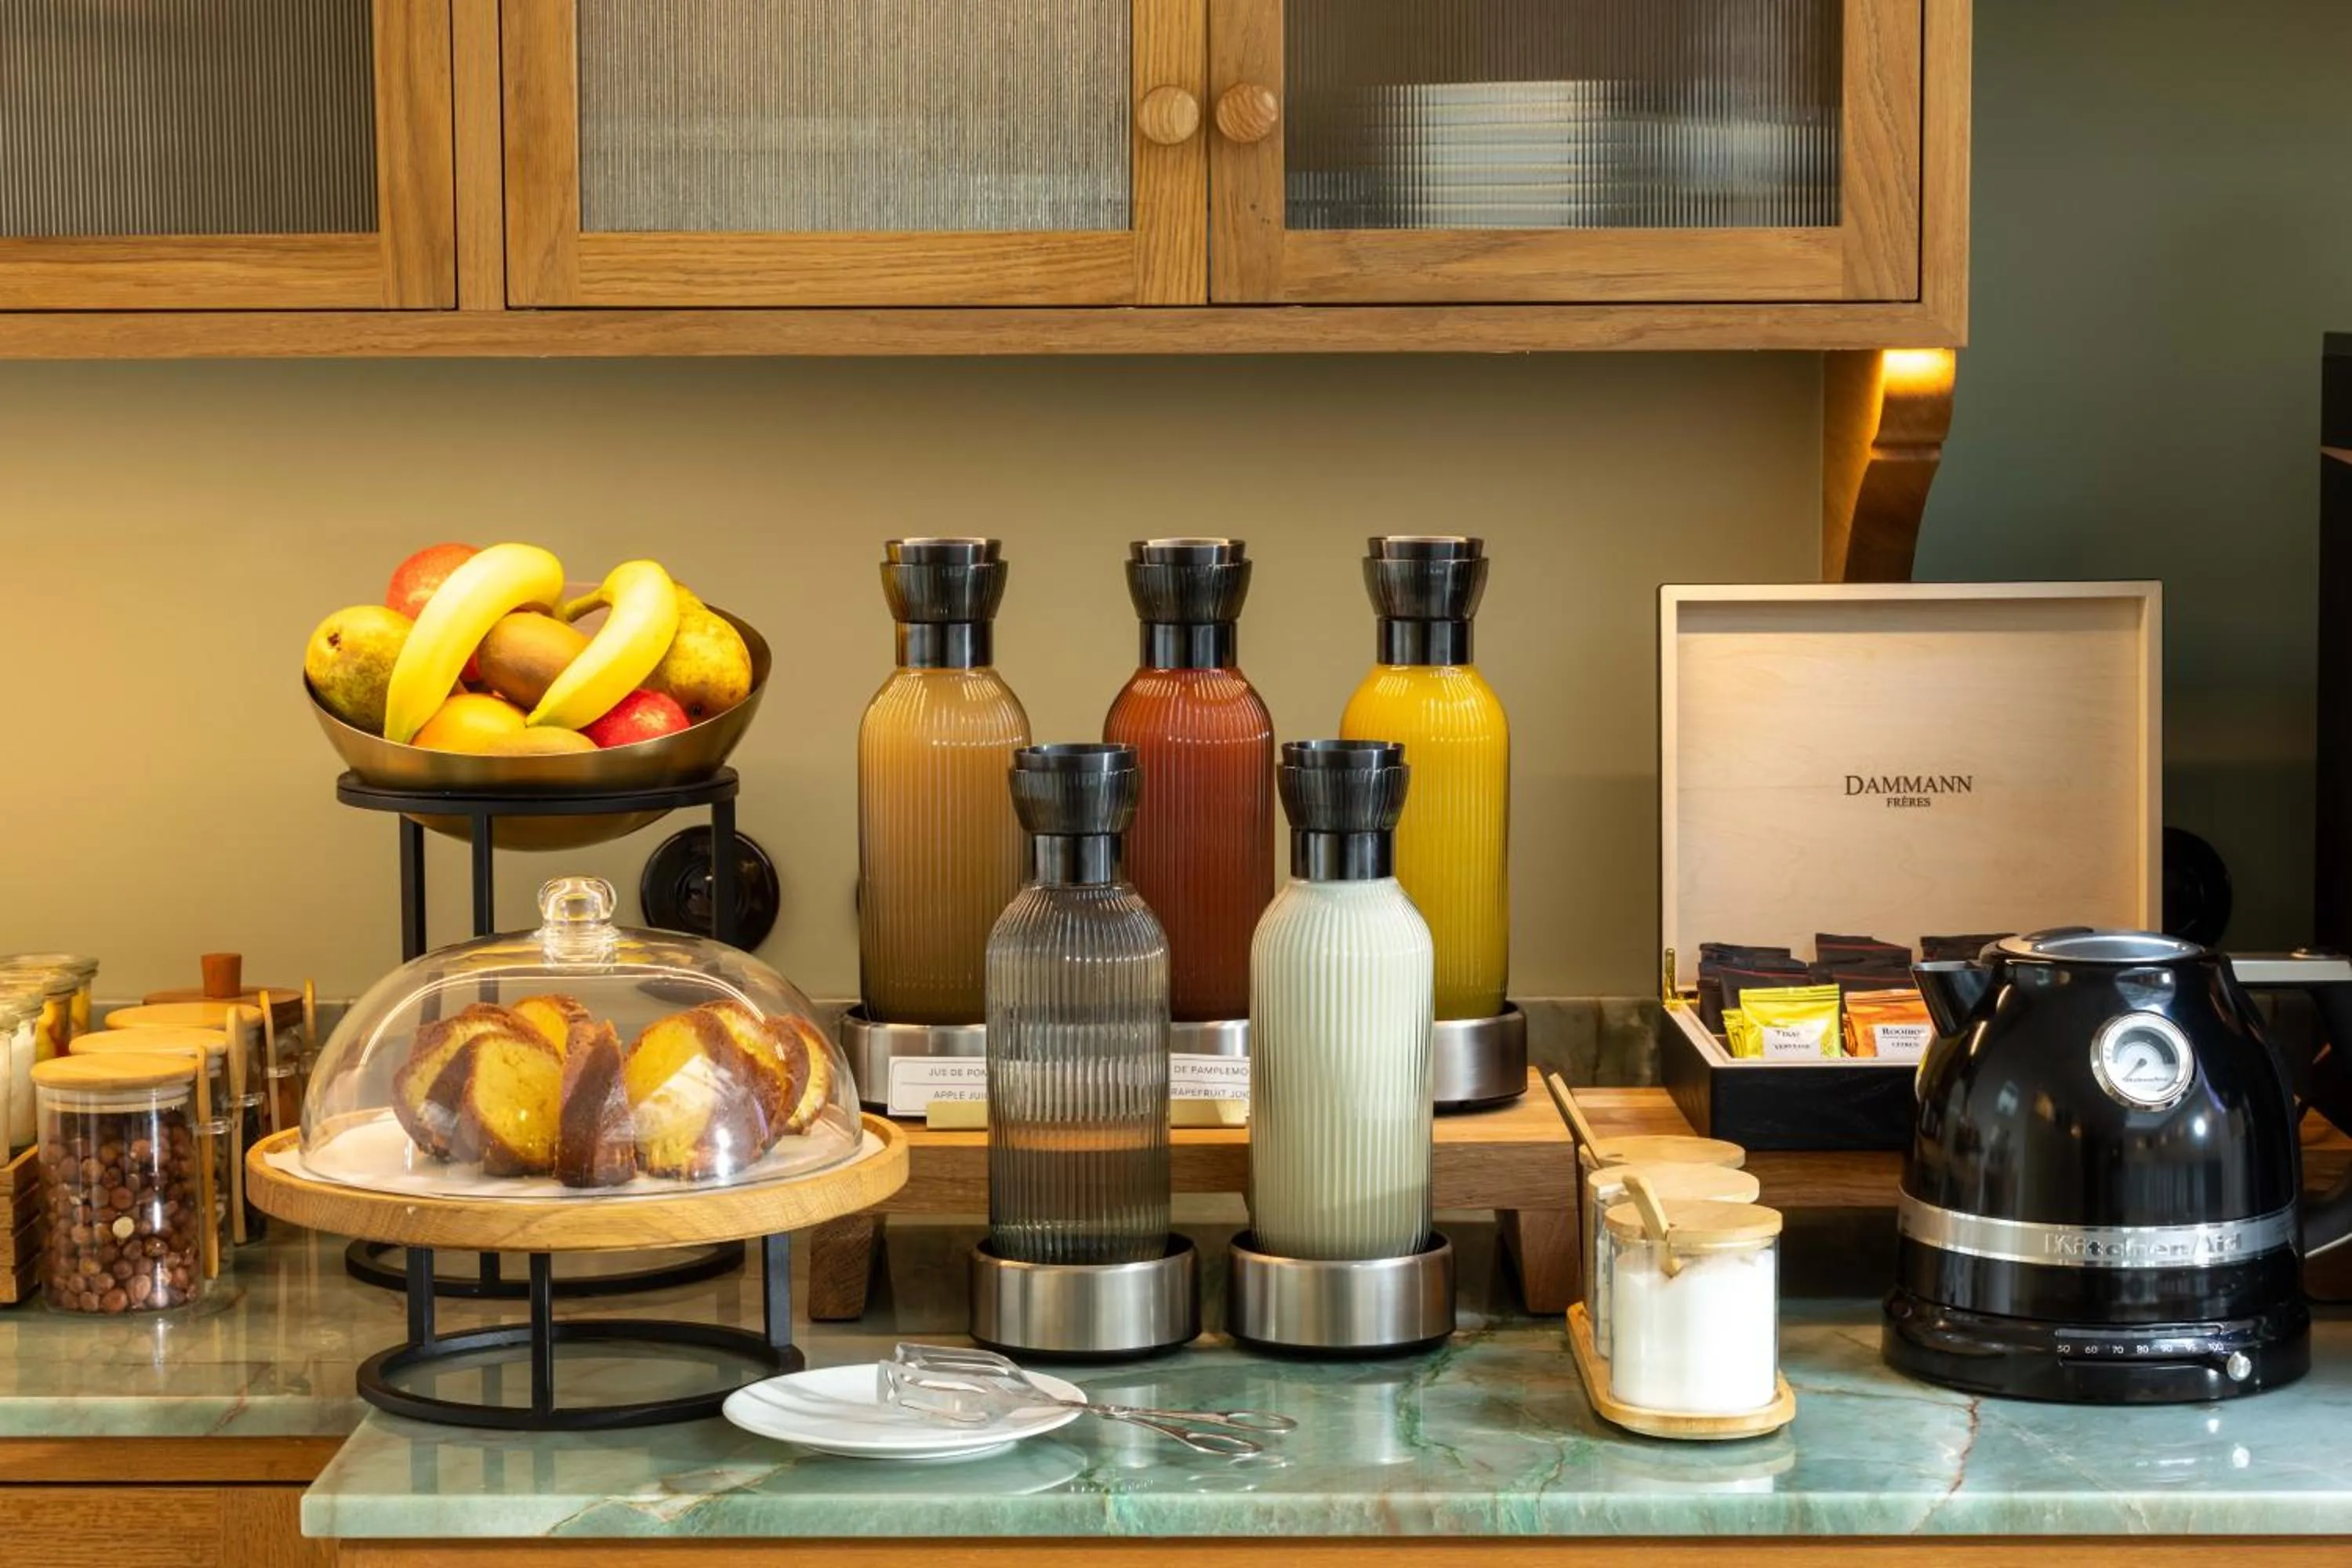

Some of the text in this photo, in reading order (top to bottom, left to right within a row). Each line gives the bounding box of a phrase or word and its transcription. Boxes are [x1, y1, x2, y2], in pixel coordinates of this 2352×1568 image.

[1845, 775, 1973, 796] DAMMANN
[1886, 795, 1931, 808] FRÈRES
[928, 1068, 947, 1076] JUS
[950, 1068, 963, 1076] DE
[1174, 1065, 1249, 1076] DE PAMPLEMO
[933, 1091, 987, 1100] APPLE JUI
[1171, 1087, 1226, 1098] RAPEFRUIT
[2044, 1231, 2242, 1256] KitchenAid
[2056, 1345, 2071, 1353] 50
[2085, 1345, 2098, 1354] 60
[2112, 1345, 2124, 1354] 70
[2136, 1345, 2149, 1354] 80
[2160, 1344, 2172, 1352] 90
[2208, 1342, 2223, 1352] 100
